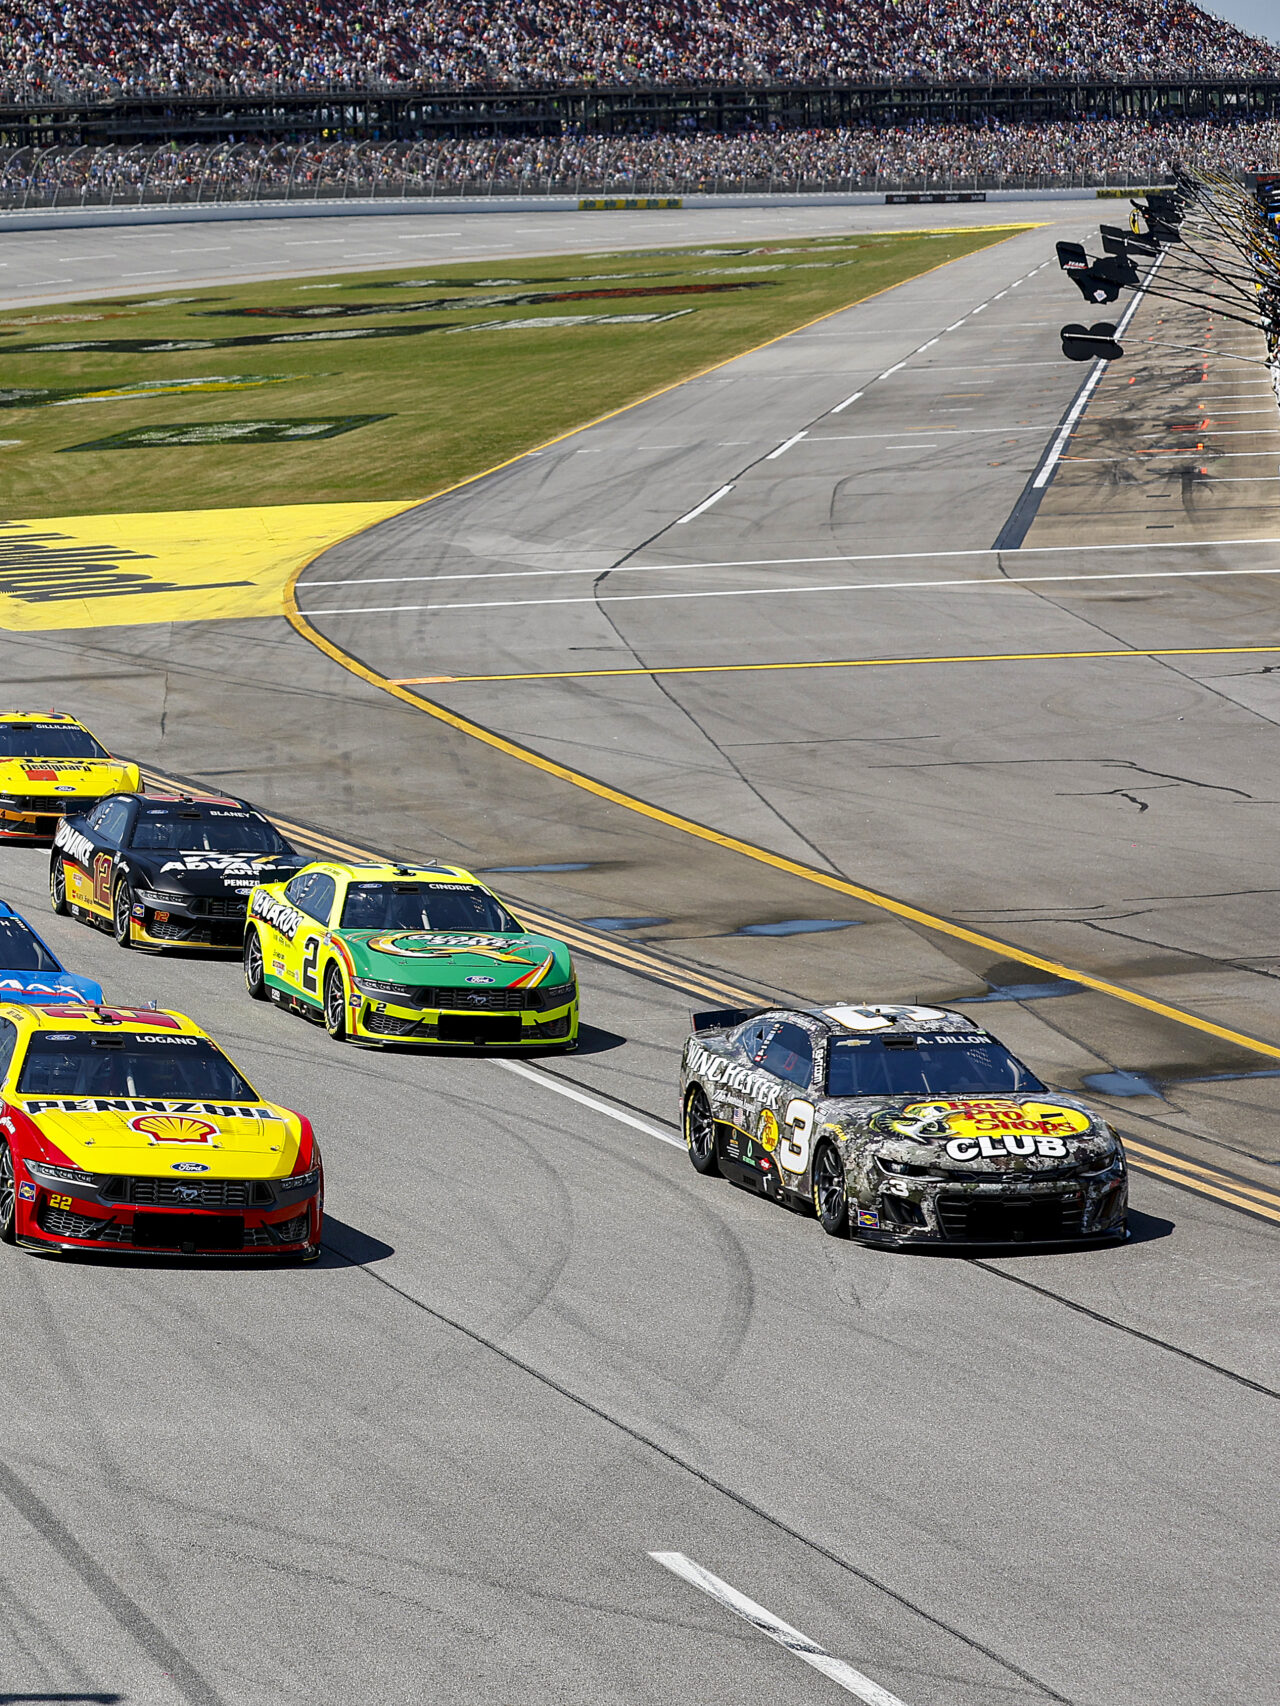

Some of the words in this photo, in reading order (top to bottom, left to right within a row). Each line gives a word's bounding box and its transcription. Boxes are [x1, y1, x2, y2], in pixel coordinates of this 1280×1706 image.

[210, 810, 250, 818] BLANEY
[94, 852, 113, 907] 12
[429, 883, 475, 892] CINDRIC
[154, 911, 170, 922] 12
[302, 934, 320, 995] 2
[375, 1002, 387, 1013] 2
[135, 1034, 198, 1046] LOGANO
[917, 1036, 930, 1045] A.
[935, 1035, 992, 1045] DILLON
[685, 1040, 782, 1110] WINCHESTER
[23, 1099, 285, 1120] PENNZOIL
[948, 1101, 1019, 1111] Bass
[965, 1109, 1023, 1122] Pro
[975, 1118, 1078, 1135] Shops
[780, 1098, 816, 1175] 3
[945, 1135, 1068, 1160] CLUB
[176, 1162, 206, 1172] Ford
[888, 1179, 910, 1197] 3
[50, 1194, 73, 1211] 22
